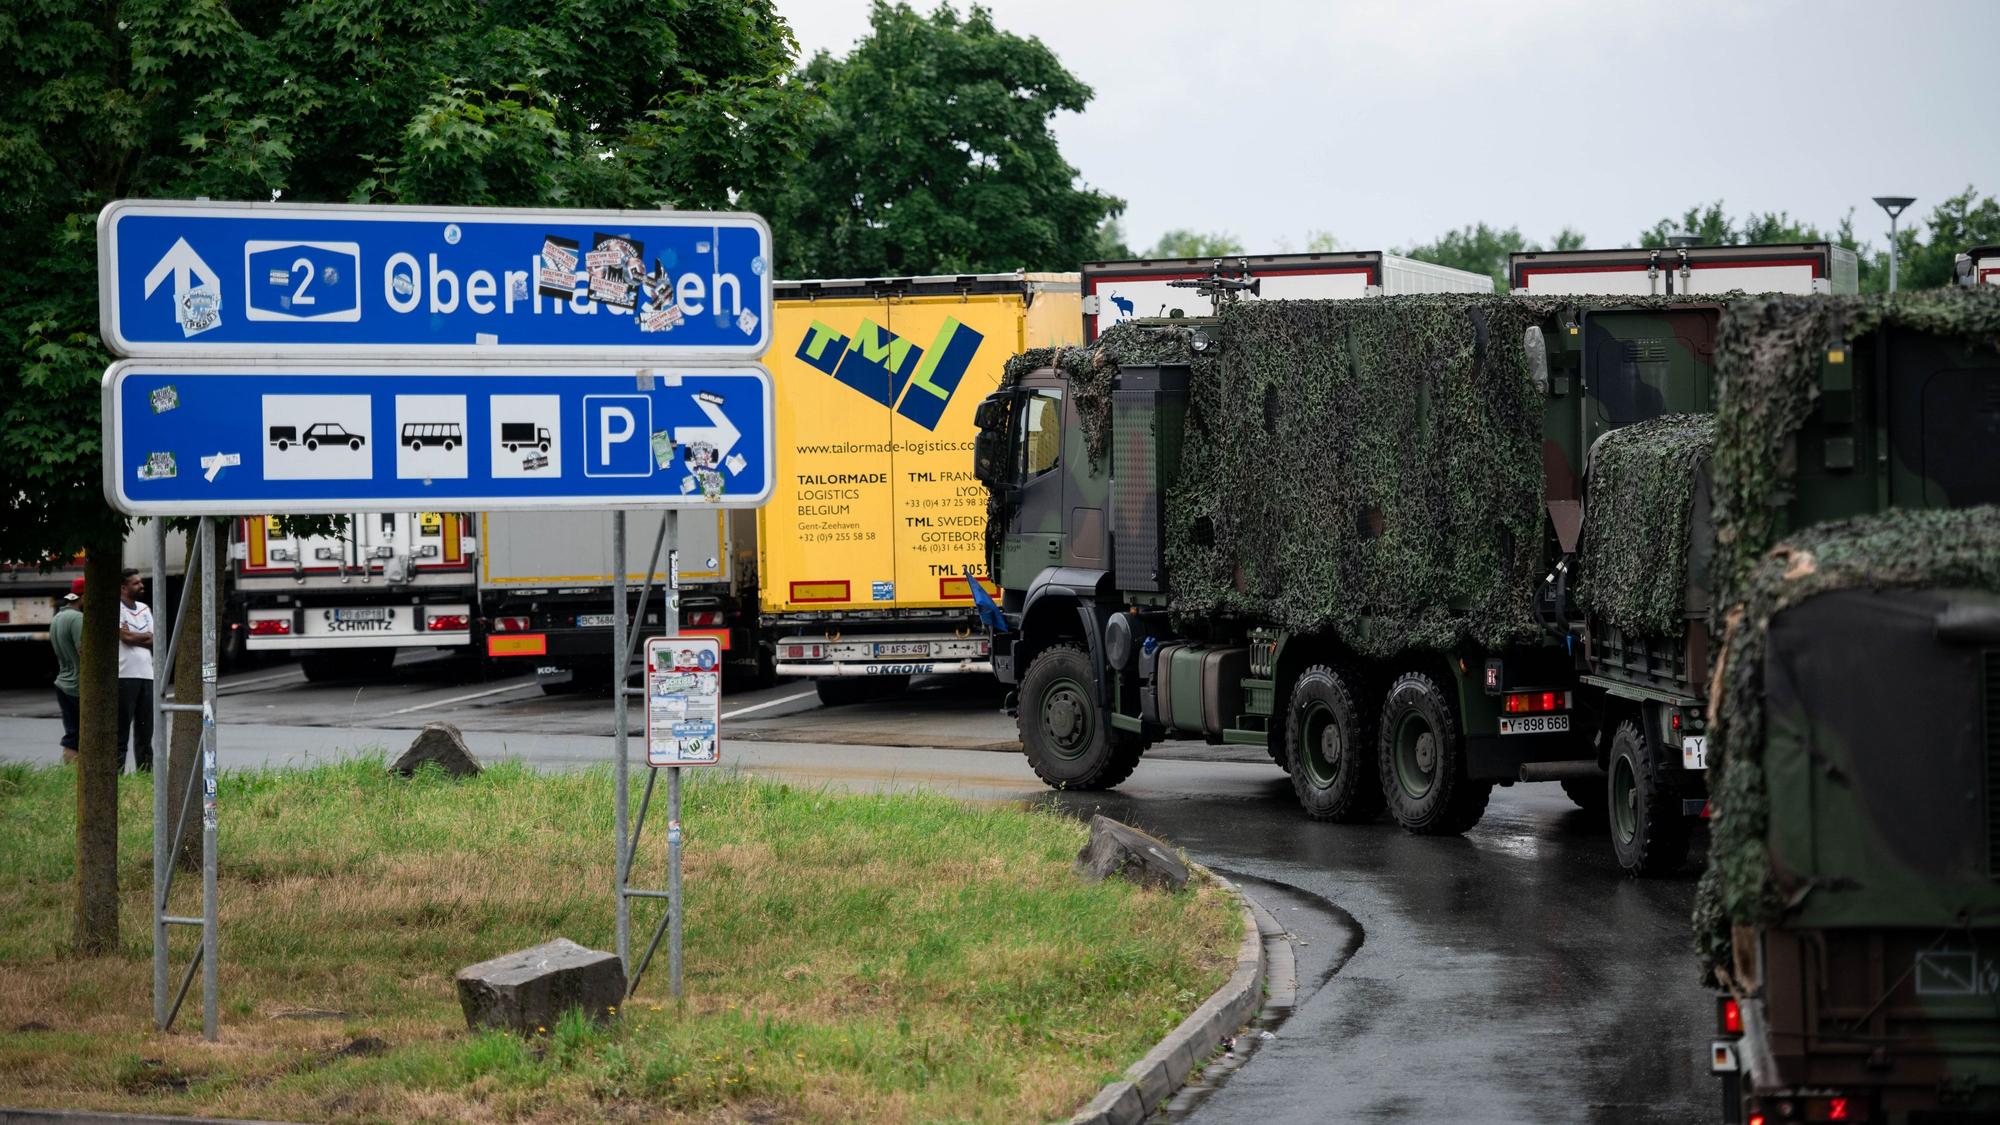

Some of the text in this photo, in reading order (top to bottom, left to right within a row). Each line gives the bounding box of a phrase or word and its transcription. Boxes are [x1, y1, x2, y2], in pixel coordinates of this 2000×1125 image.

[292, 258, 315, 305] 2
[384, 252, 740, 317] Oberhaen
[804, 314, 963, 402] TML
[601, 406, 636, 466] P
[797, 440, 975, 455] www.tailormade-logistics.co
[797, 473, 887, 485] TAILORMADE
[908, 471, 975, 483] TML FRAN
[797, 489, 860, 501] LOGISTICS
[956, 486, 989, 497] LYON
[798, 505, 850, 516] BELGIUM
[905, 517, 933, 528] TML
[928, 564, 957, 577] TML
[328, 620, 392, 632] SCHMITZ
[880, 664, 934, 674] KRONE
[1547, 717, 1568, 730] 668
